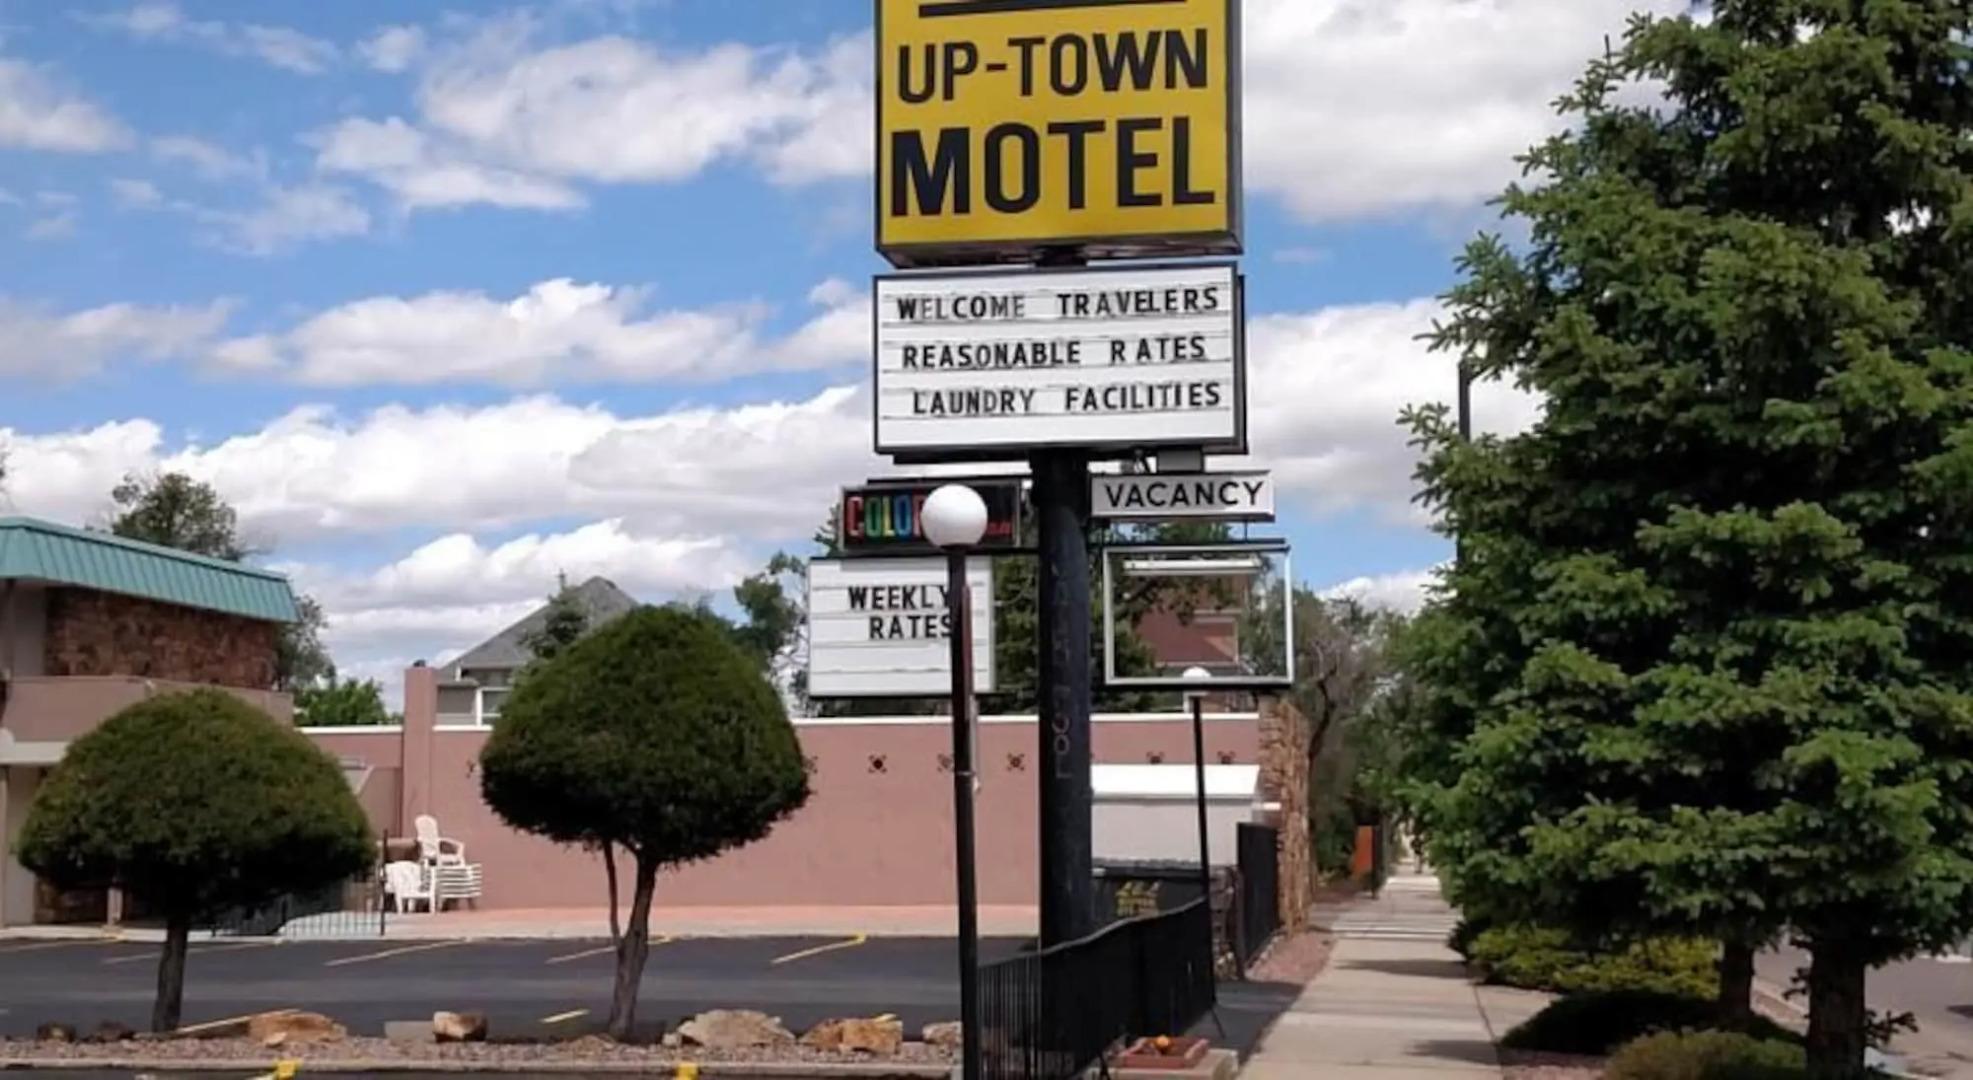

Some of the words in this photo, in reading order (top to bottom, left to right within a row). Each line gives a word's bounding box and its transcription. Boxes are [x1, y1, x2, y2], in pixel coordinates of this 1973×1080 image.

[898, 28, 1208, 103] UP-TOWN
[891, 116, 1215, 217] MOTEL
[897, 295, 1025, 321] WELCOME
[1057, 287, 1219, 316] TRAVELERS
[902, 341, 1081, 369] REASONABLE
[1110, 336, 1206, 362] RATES
[913, 389, 1035, 414] LAUNDRY
[1064, 382, 1221, 410] FACILITIES
[1105, 481, 1264, 508] VACANCY
[848, 585, 951, 609] WEEKLY
[869, 615, 952, 639] RATES
